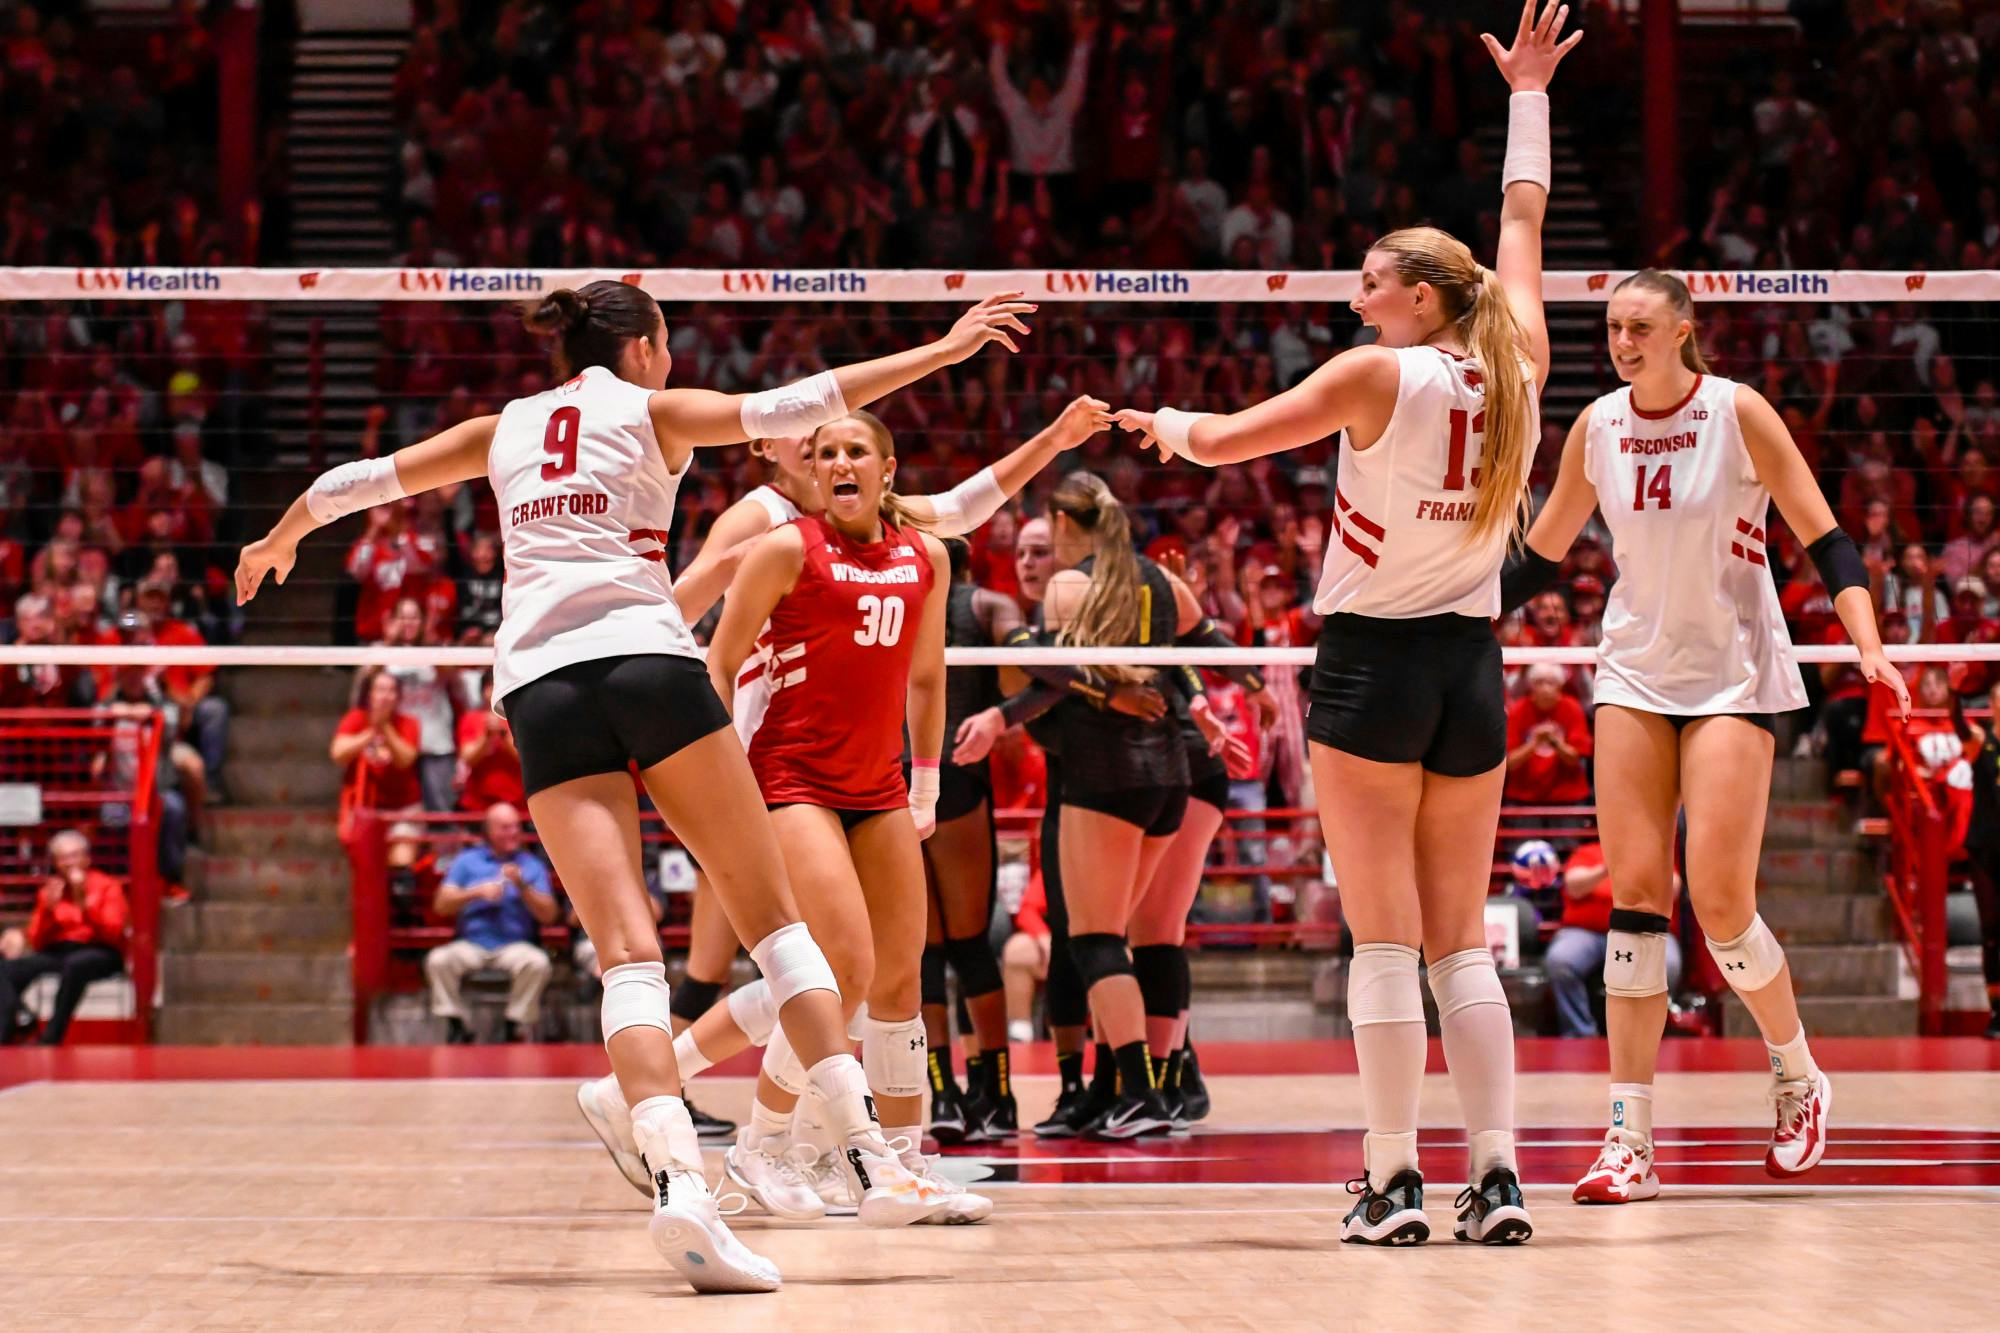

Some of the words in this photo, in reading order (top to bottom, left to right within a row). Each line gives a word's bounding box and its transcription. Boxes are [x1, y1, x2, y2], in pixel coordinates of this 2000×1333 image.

[540, 405, 581, 482] 9
[1620, 431, 1698, 456] WISCONSIN
[1633, 464, 1672, 511] 14
[512, 493, 609, 527] CRAWFORD
[830, 563, 920, 585] WISCONSIN
[853, 594, 905, 647] 30
